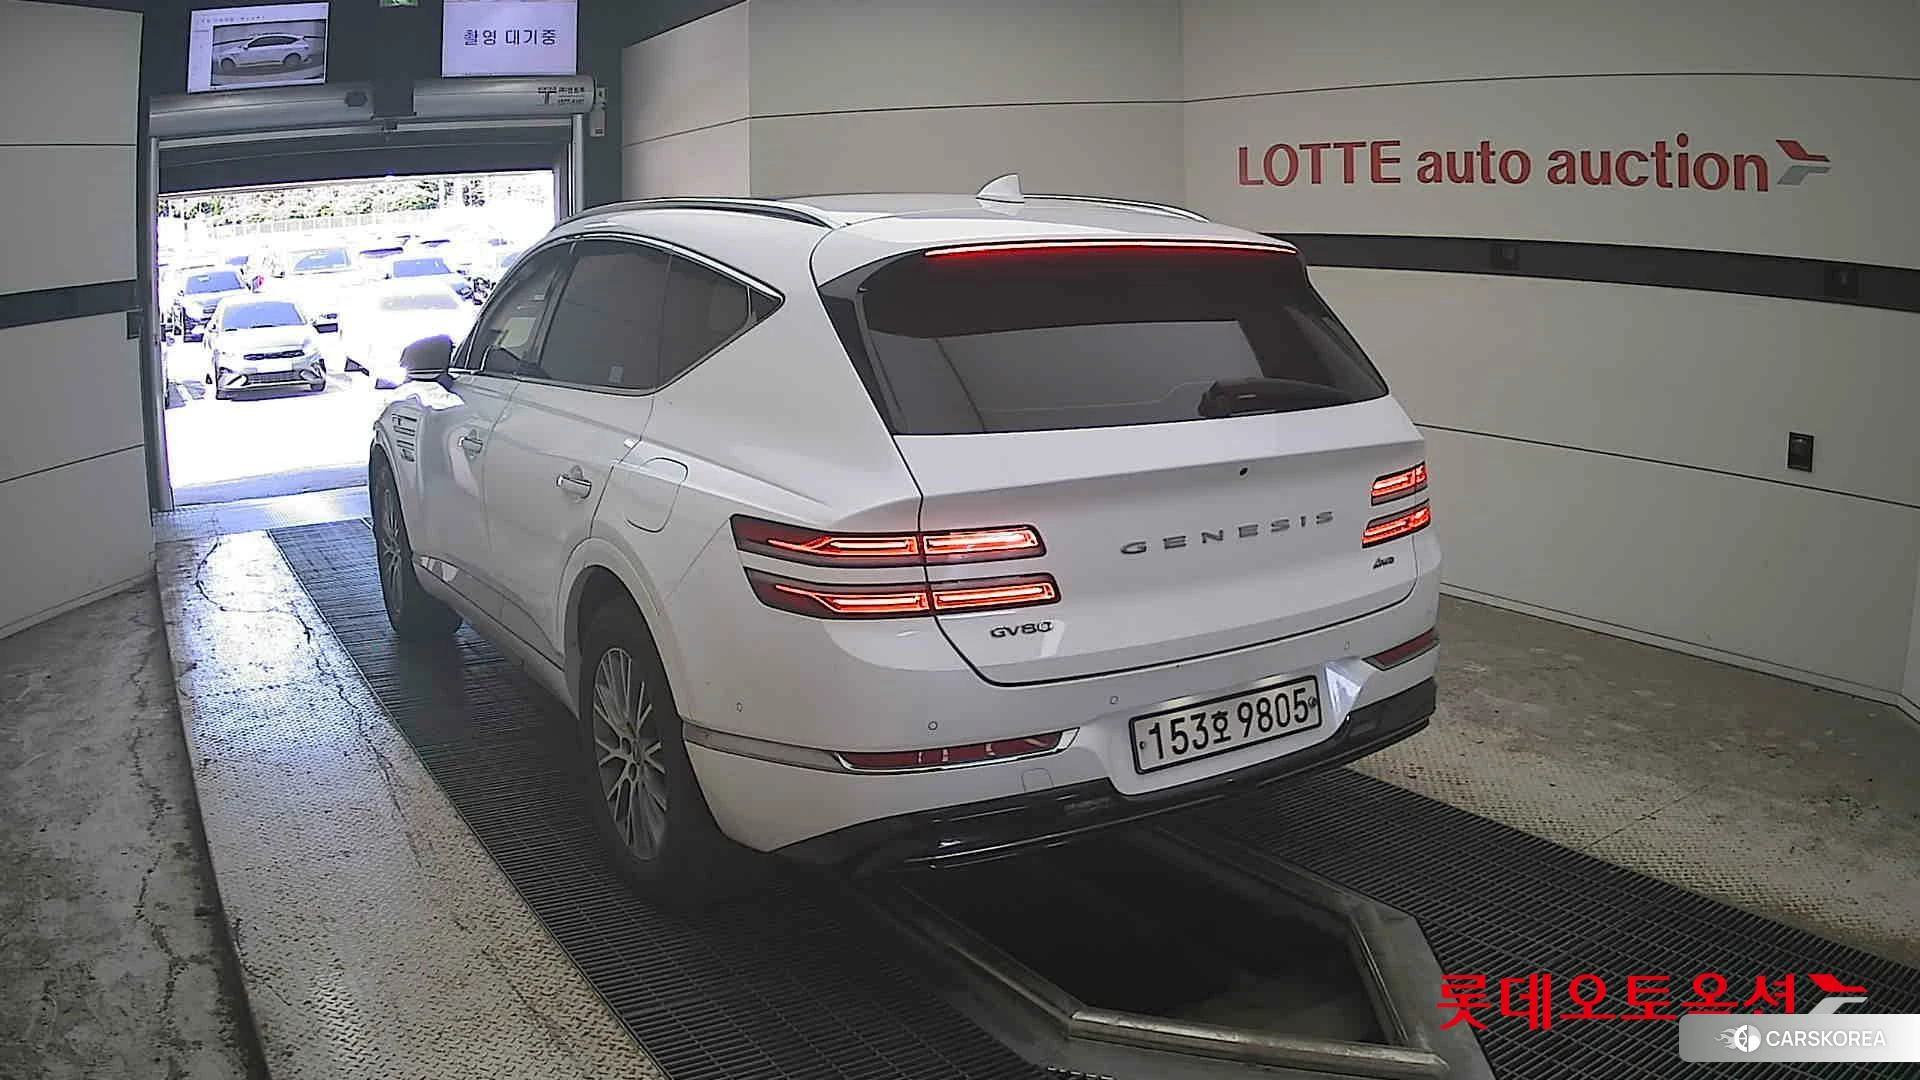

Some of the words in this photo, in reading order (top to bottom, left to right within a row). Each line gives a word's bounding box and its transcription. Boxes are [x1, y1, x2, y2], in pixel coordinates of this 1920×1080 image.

[505, 29, 557, 46] 대기중
[1238, 140, 1401, 187] LOTTE
[1416, 140, 1532, 185] auto
[1547, 132, 1769, 192] auction
[1119, 510, 1334, 555] GENESIS
[990, 621, 1053, 638] GV80
